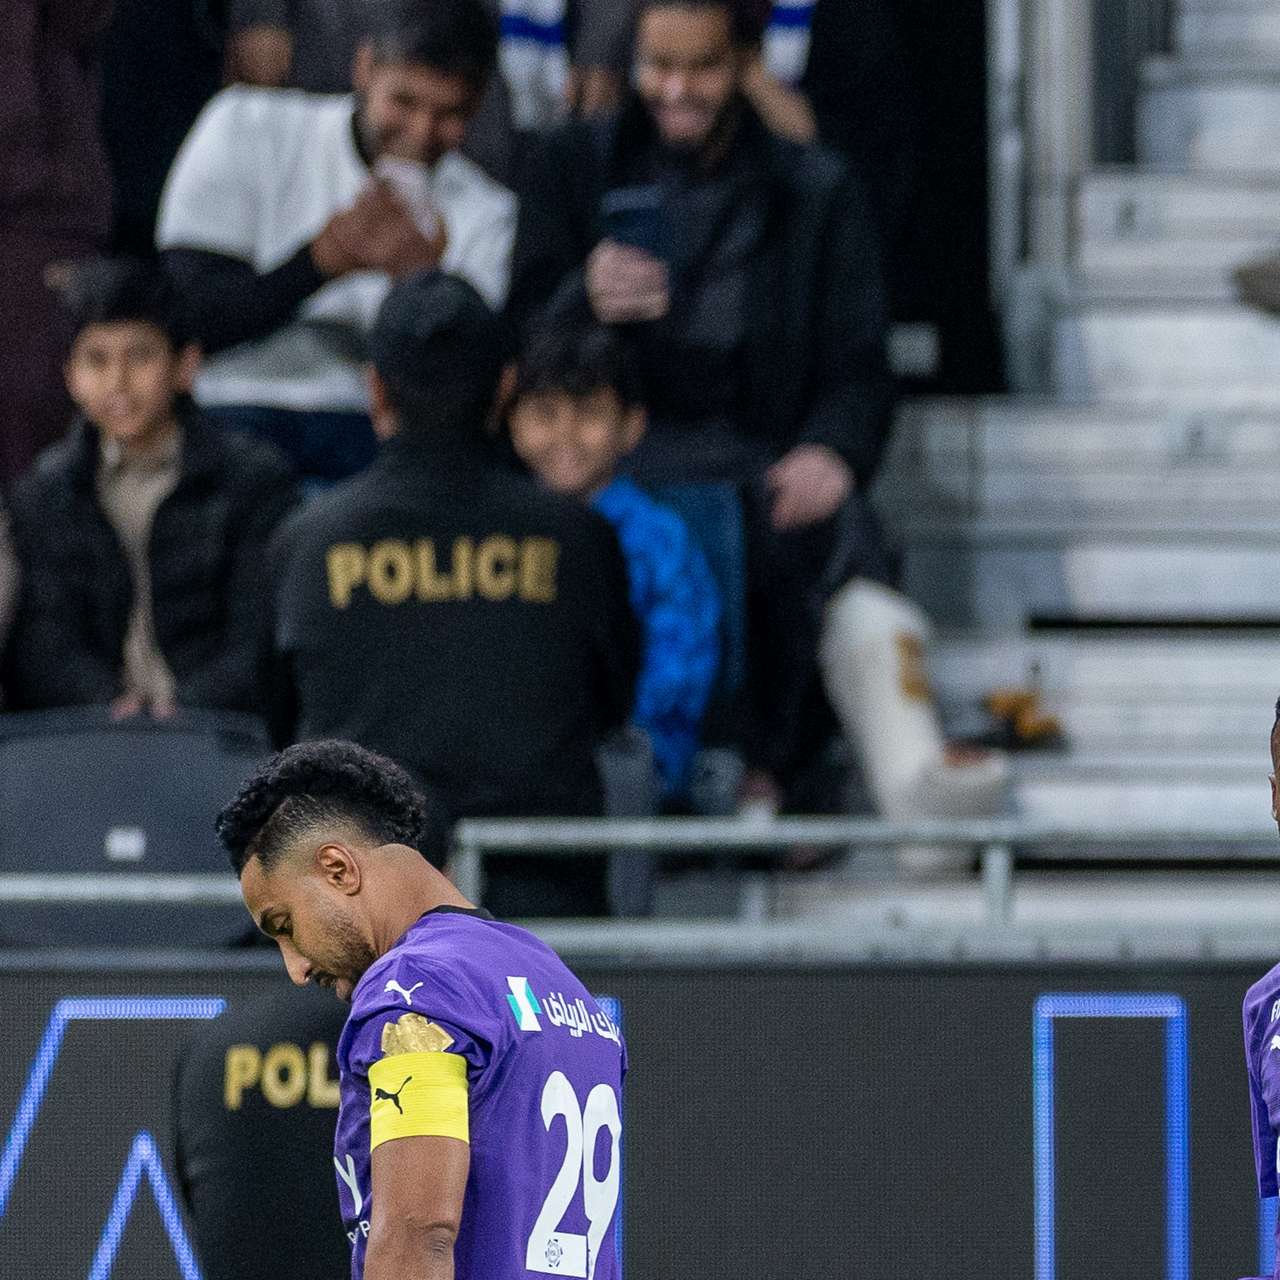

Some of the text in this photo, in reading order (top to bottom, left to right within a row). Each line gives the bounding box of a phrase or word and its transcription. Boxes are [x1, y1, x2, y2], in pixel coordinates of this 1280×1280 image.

[328, 538, 558, 608] POLICE
[542, 991, 593, 1038] الرياض
[223, 1042, 341, 1111] POL
